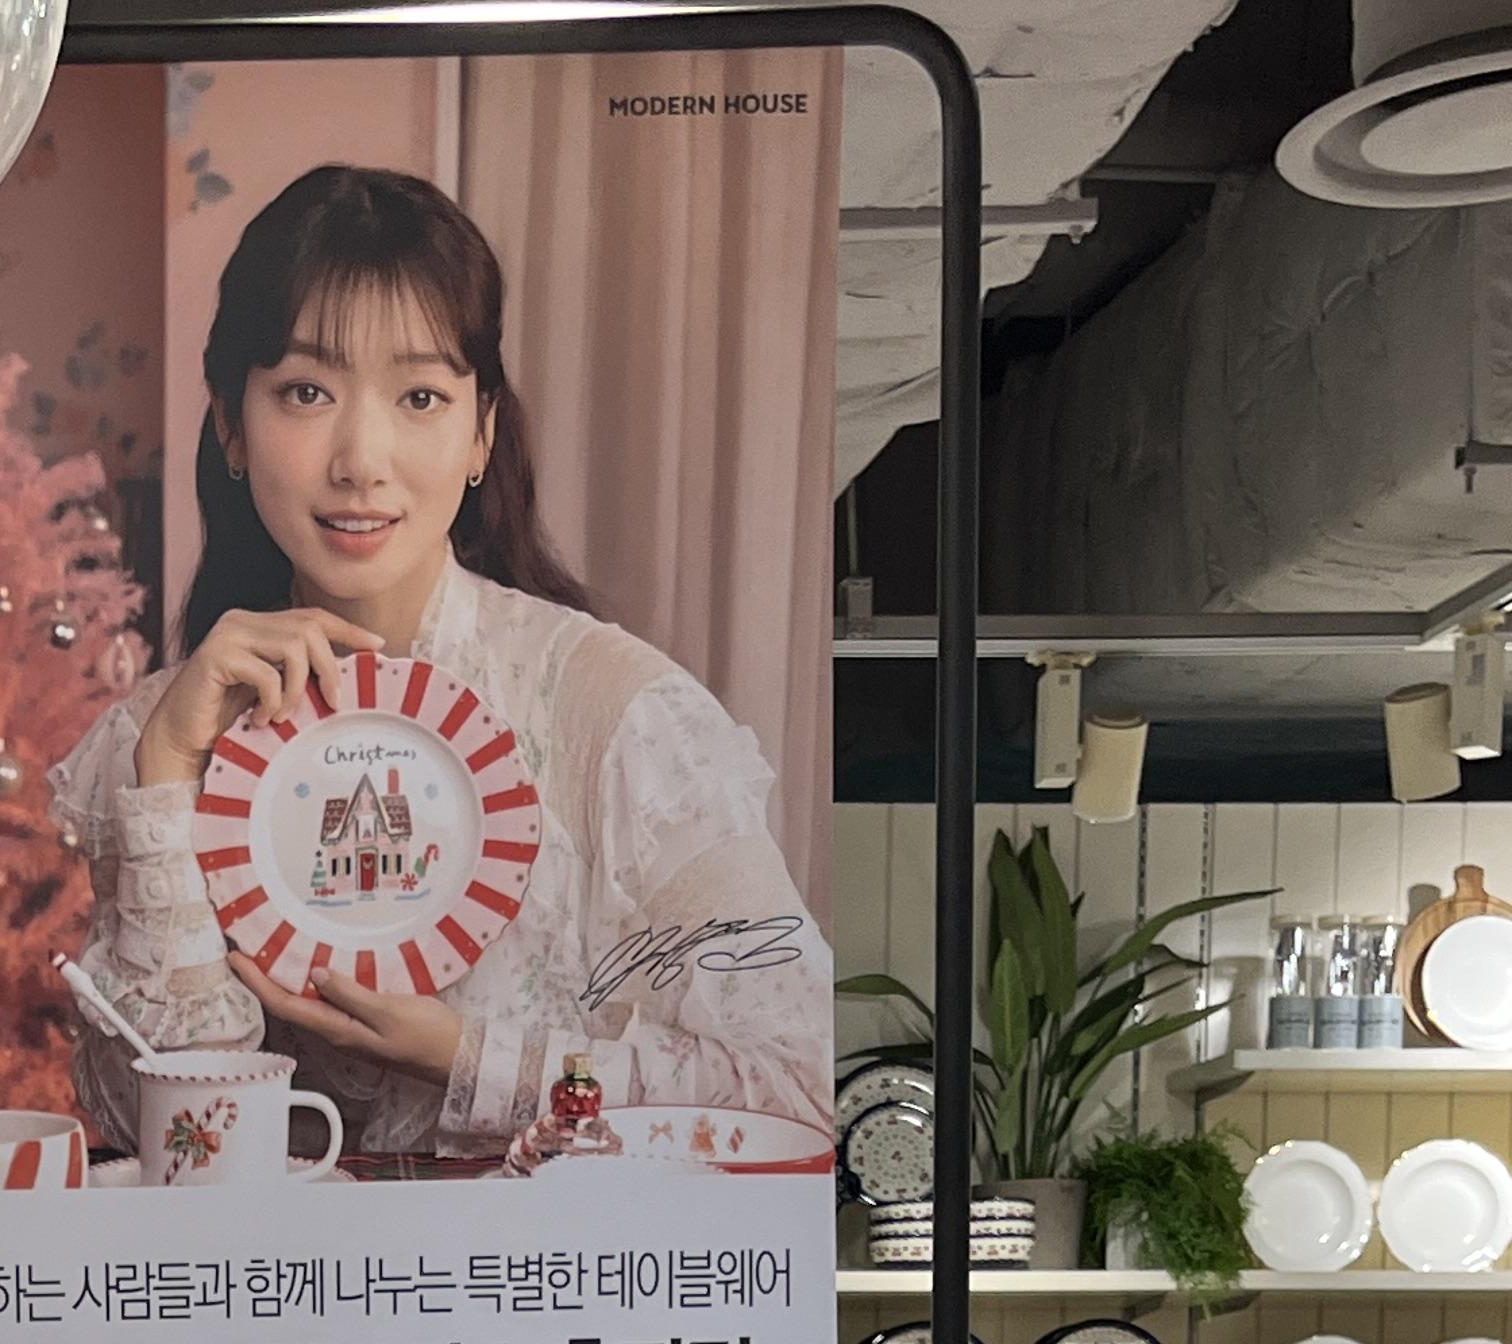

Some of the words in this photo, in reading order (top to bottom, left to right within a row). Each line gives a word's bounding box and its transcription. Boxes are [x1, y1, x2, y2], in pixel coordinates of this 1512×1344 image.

[609, 95, 716, 117] MODERN
[724, 94, 808, 114] HOUSE
[73, 1260, 237, 1321] 사람들과
[244, 1258, 325, 1317] 함께
[336, 1255, 457, 1316] 나누는
[463, 1251, 589, 1314] 특별한
[596, 1248, 792, 1310] 테이블웨어
